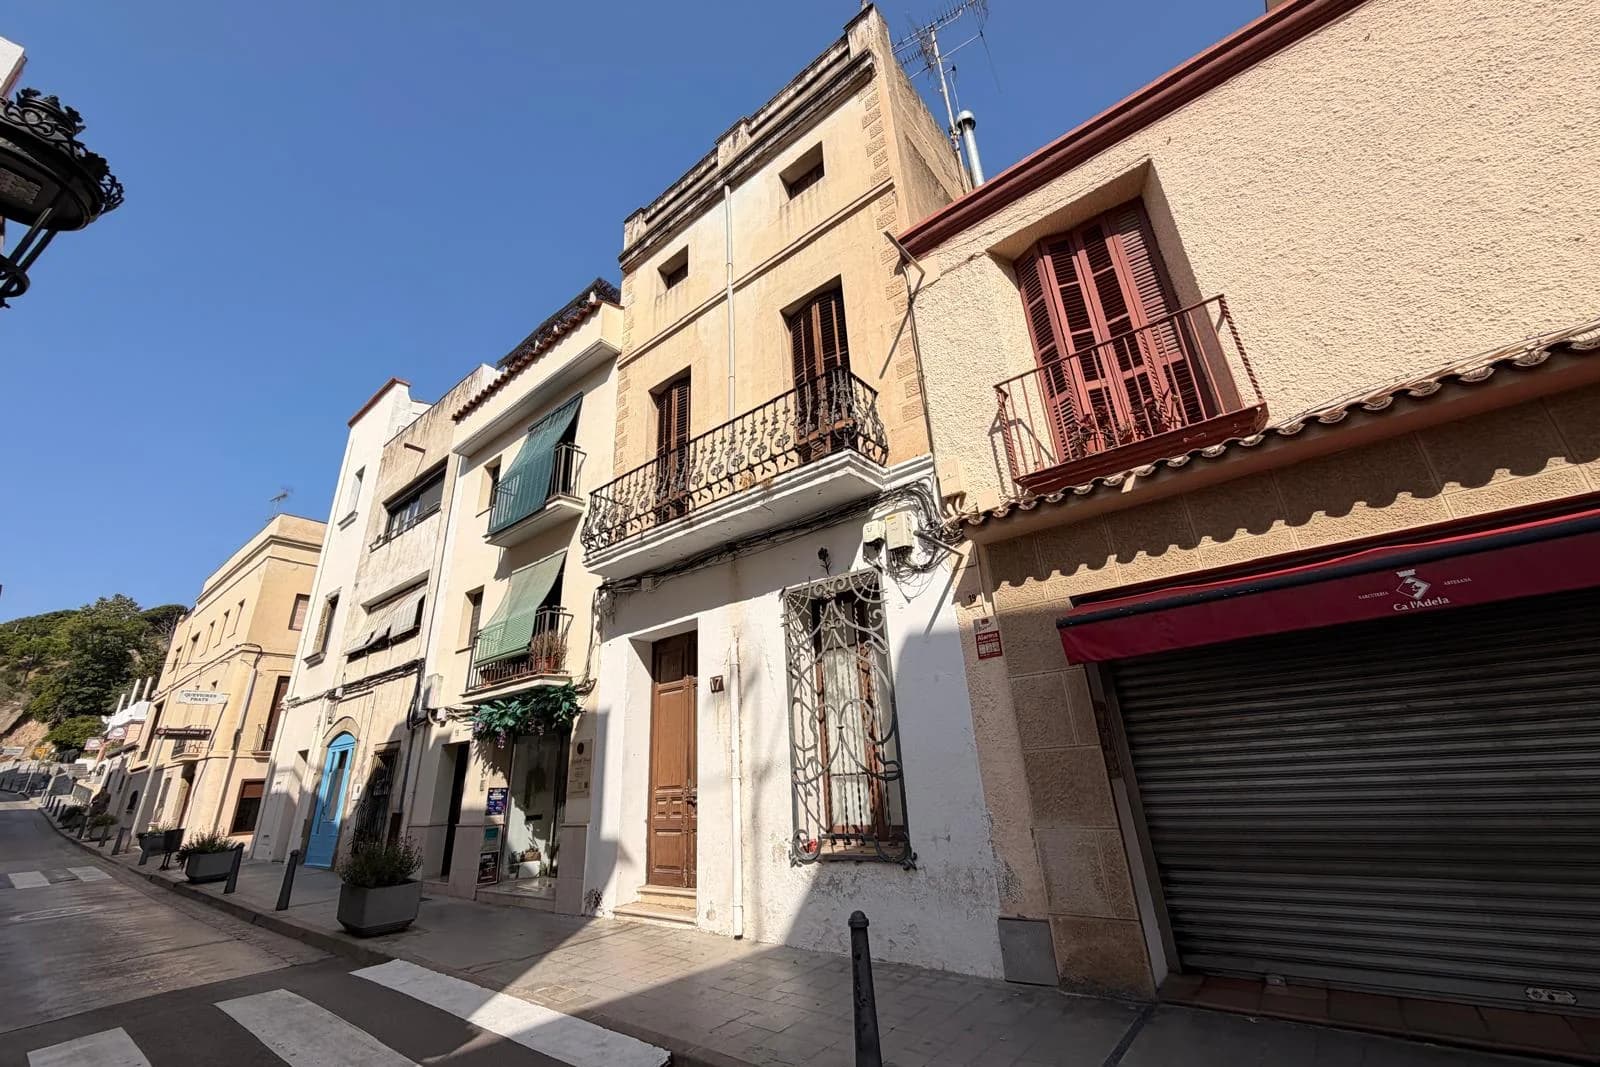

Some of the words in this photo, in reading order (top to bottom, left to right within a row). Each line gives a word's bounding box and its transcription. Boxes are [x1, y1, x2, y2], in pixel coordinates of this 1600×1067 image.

[968, 593, 976, 604] 19
[1393, 603, 1409, 612] Ca
[1410, 596, 1450, 609] l'Adela
[710, 677, 722, 691] 17
